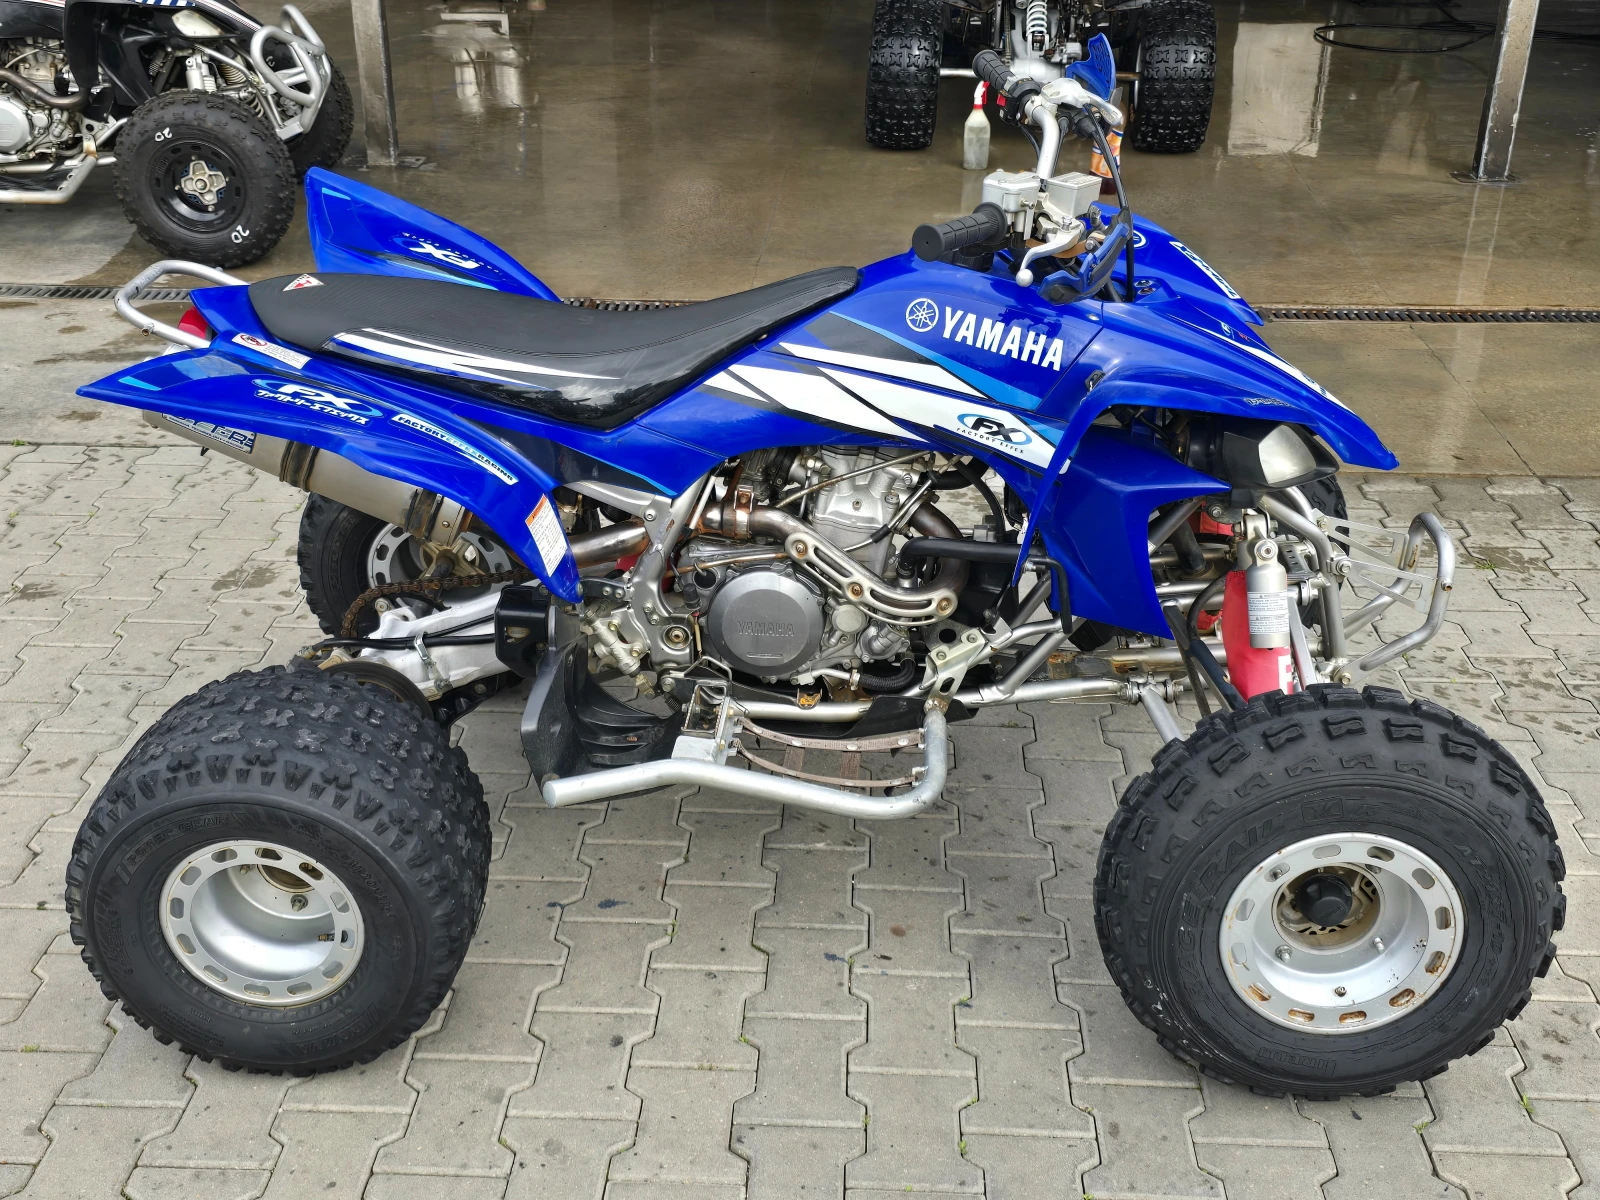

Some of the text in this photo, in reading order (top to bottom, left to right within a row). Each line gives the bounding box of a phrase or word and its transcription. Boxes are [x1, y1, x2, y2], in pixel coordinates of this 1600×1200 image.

[154, 127, 173, 142] 20
[231, 224, 250, 243] 20
[942, 306, 1064, 372] YAMAHA
[277, 384, 362, 410] FX
[956, 427, 1024, 454] FACTORY EFFEX
[970, 417, 1022, 443] FX
[737, 620, 795, 637] YAMAHA
